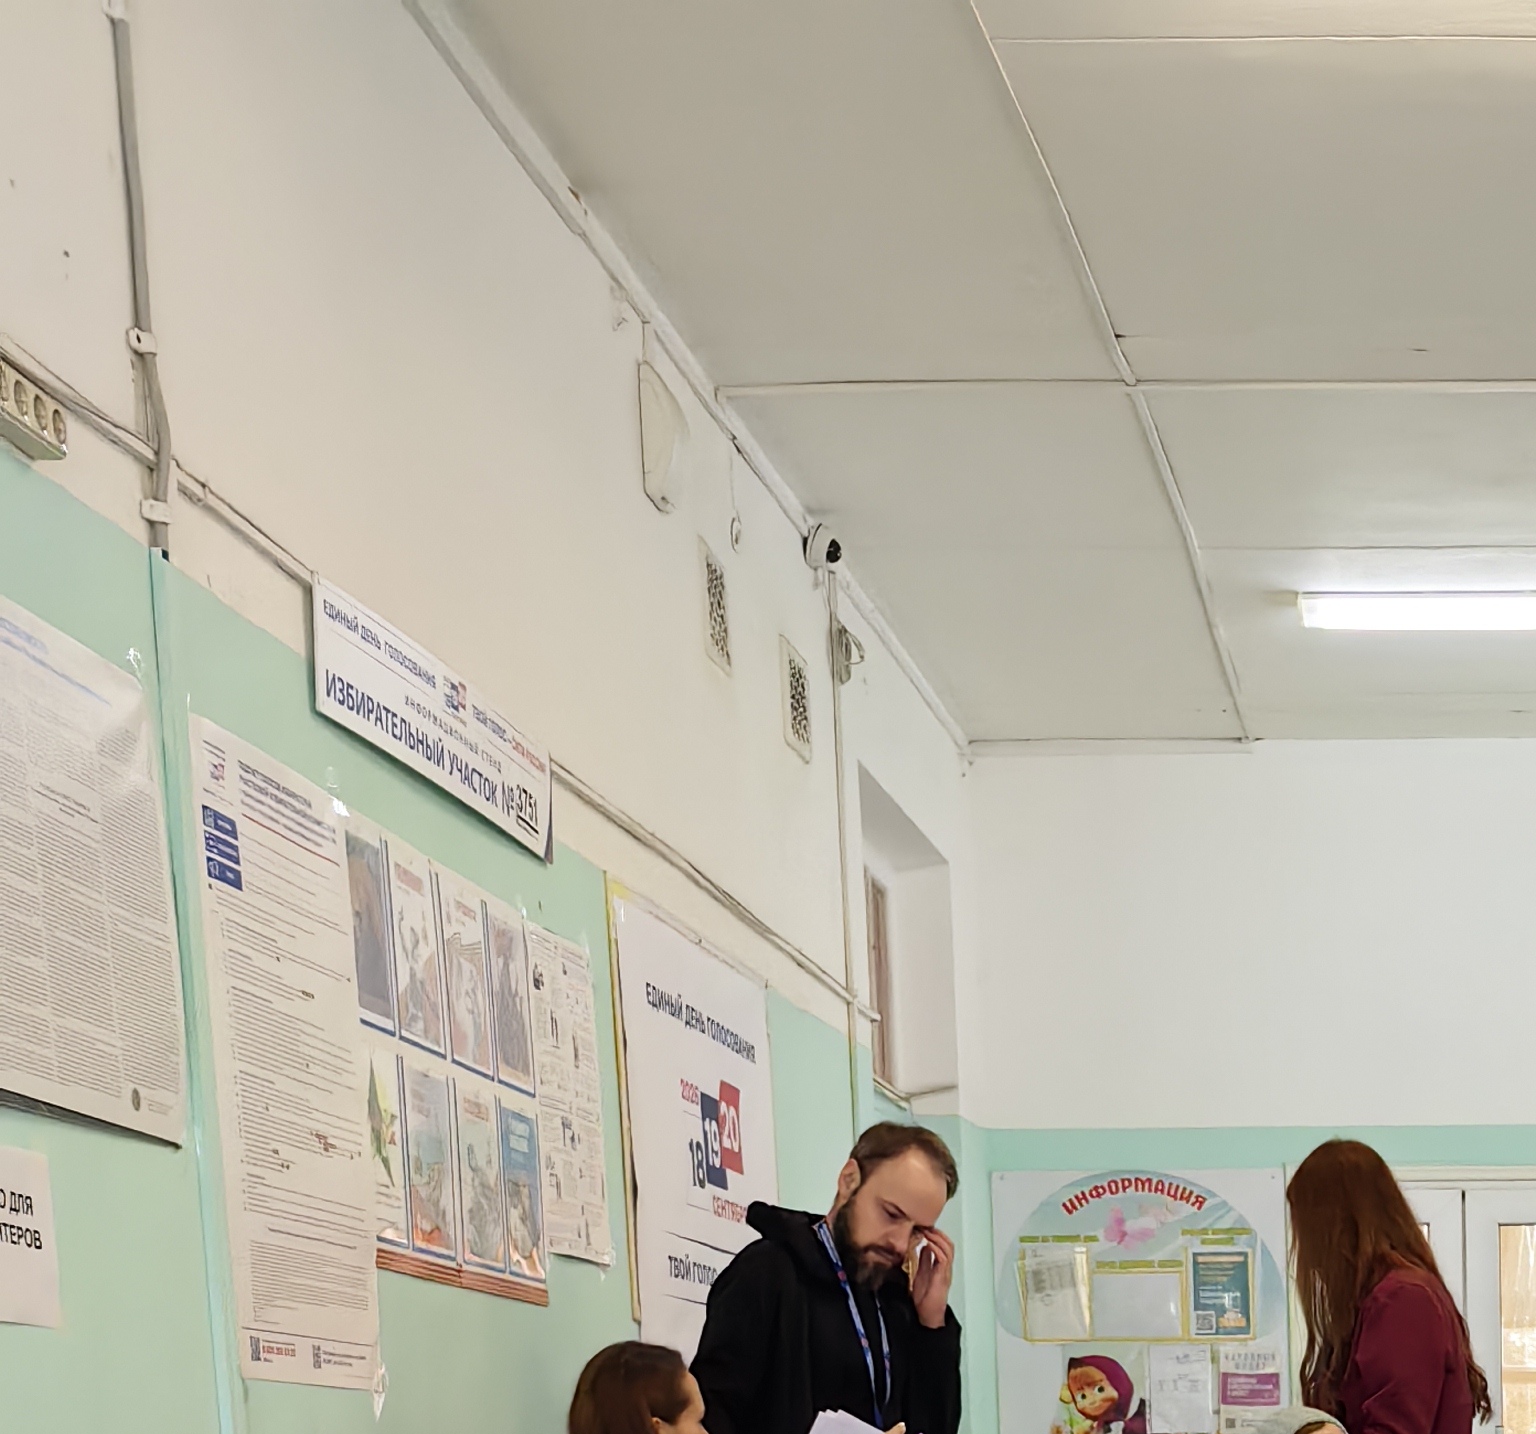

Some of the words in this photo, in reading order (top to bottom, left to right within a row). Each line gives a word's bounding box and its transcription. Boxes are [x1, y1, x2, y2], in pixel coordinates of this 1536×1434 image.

[323, 599, 359, 635] ЕДИНЫЙ
[361, 624, 381, 650] ДЕНЬ
[325, 668, 445, 771] ИЗБИРАТЕЛЬНЫЙ
[447, 749, 499, 808] УЧАСТОК
[501, 780, 515, 817] №
[515, 784, 538, 827] 3751
[645, 981, 683, 1021] ЕДИНЫЙ
[684, 1003, 706, 1034] ДЕНЬ
[706, 1015, 757, 1064] ГОЛОСОВАНИЯ
[703, 1117, 722, 1169] 19
[719, 1100, 740, 1153] 20
[689, 1137, 707, 1189] 18
[9, 1191, 34, 1217] ДЛЯ
[712, 1194, 747, 1224] СЕНТЯБР
[1061, 1176, 1208, 1216] ИНФОРМАЦИЯ
[0, 1222, 42, 1249] ТЕРОВ
[668, 1253, 691, 1282] ТВОЙ
